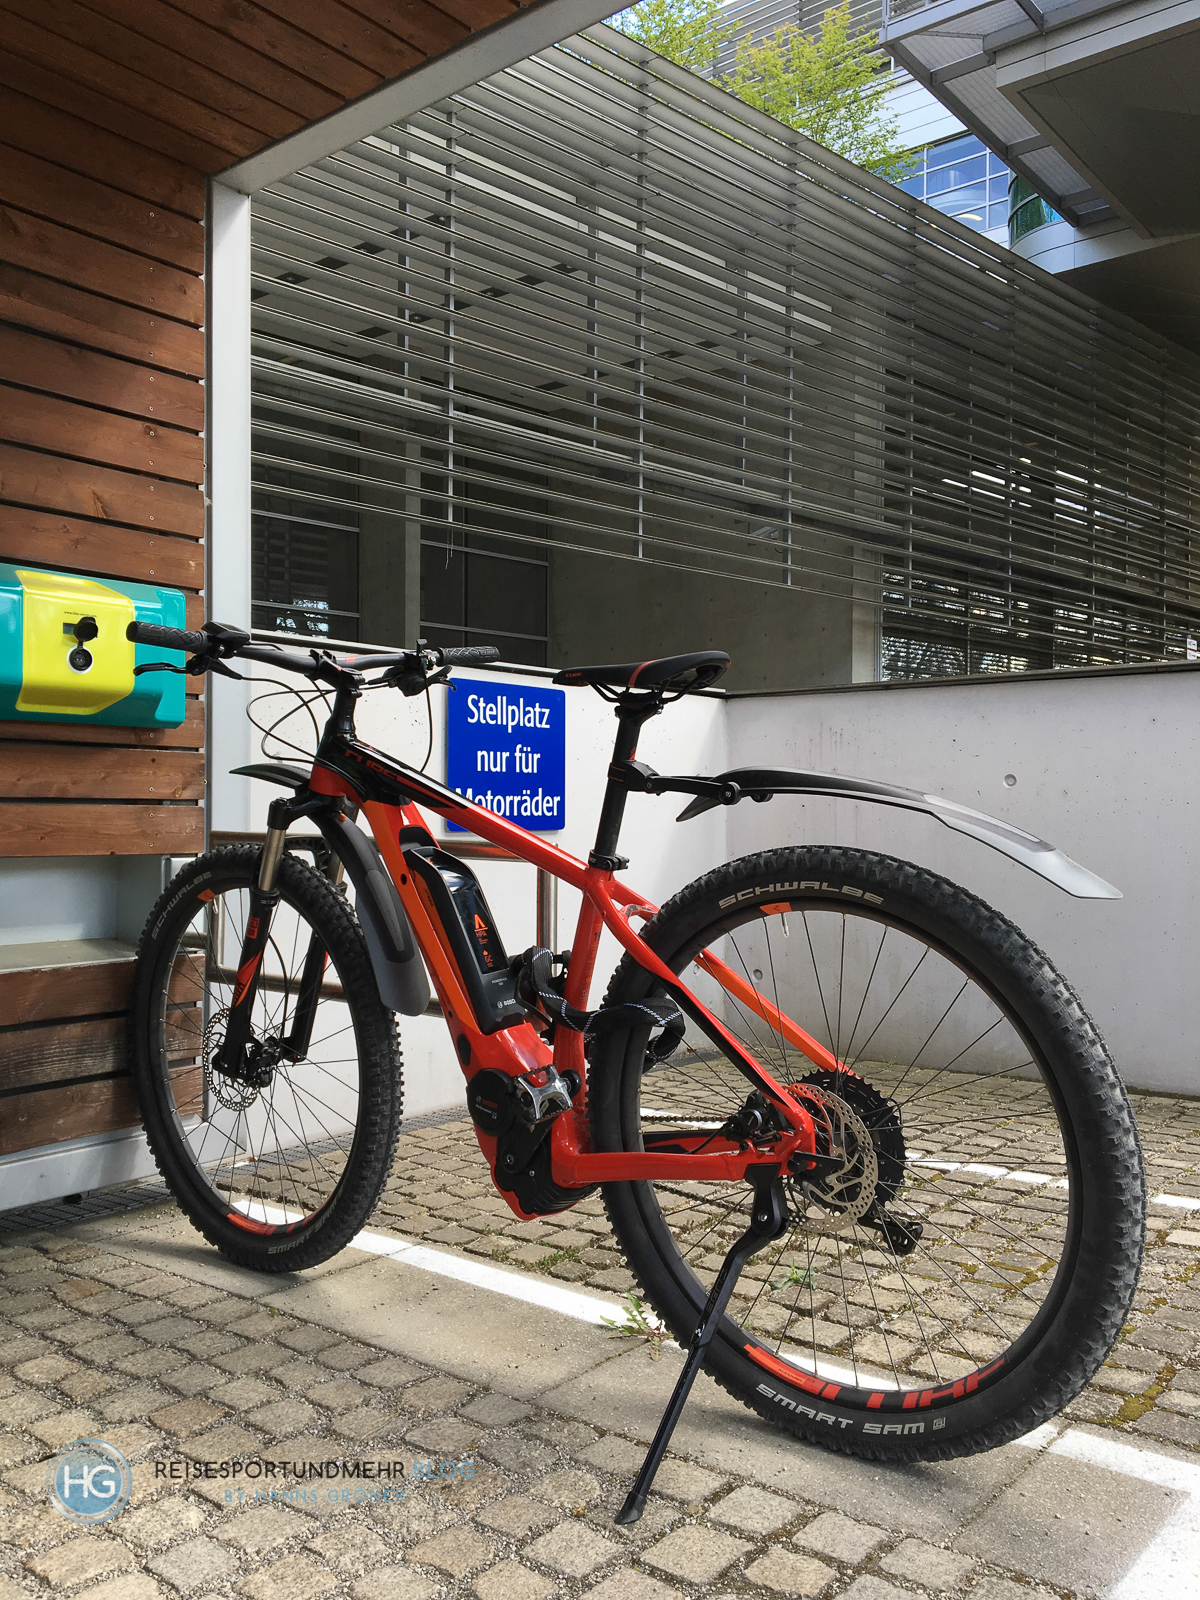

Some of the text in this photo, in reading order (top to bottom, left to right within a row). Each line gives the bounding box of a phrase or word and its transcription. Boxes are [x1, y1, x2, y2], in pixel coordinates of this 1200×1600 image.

[467, 694, 550, 733] Stellplatz
[477, 744, 540, 773] nur für
[151, 871, 212, 940] SCHWALBE
[718, 881, 884, 909] SCHWALBE
[267, 1230, 312, 1254] SMART
[755, 1383, 854, 1429] SMART
[862, 1422, 925, 1435] SAM
